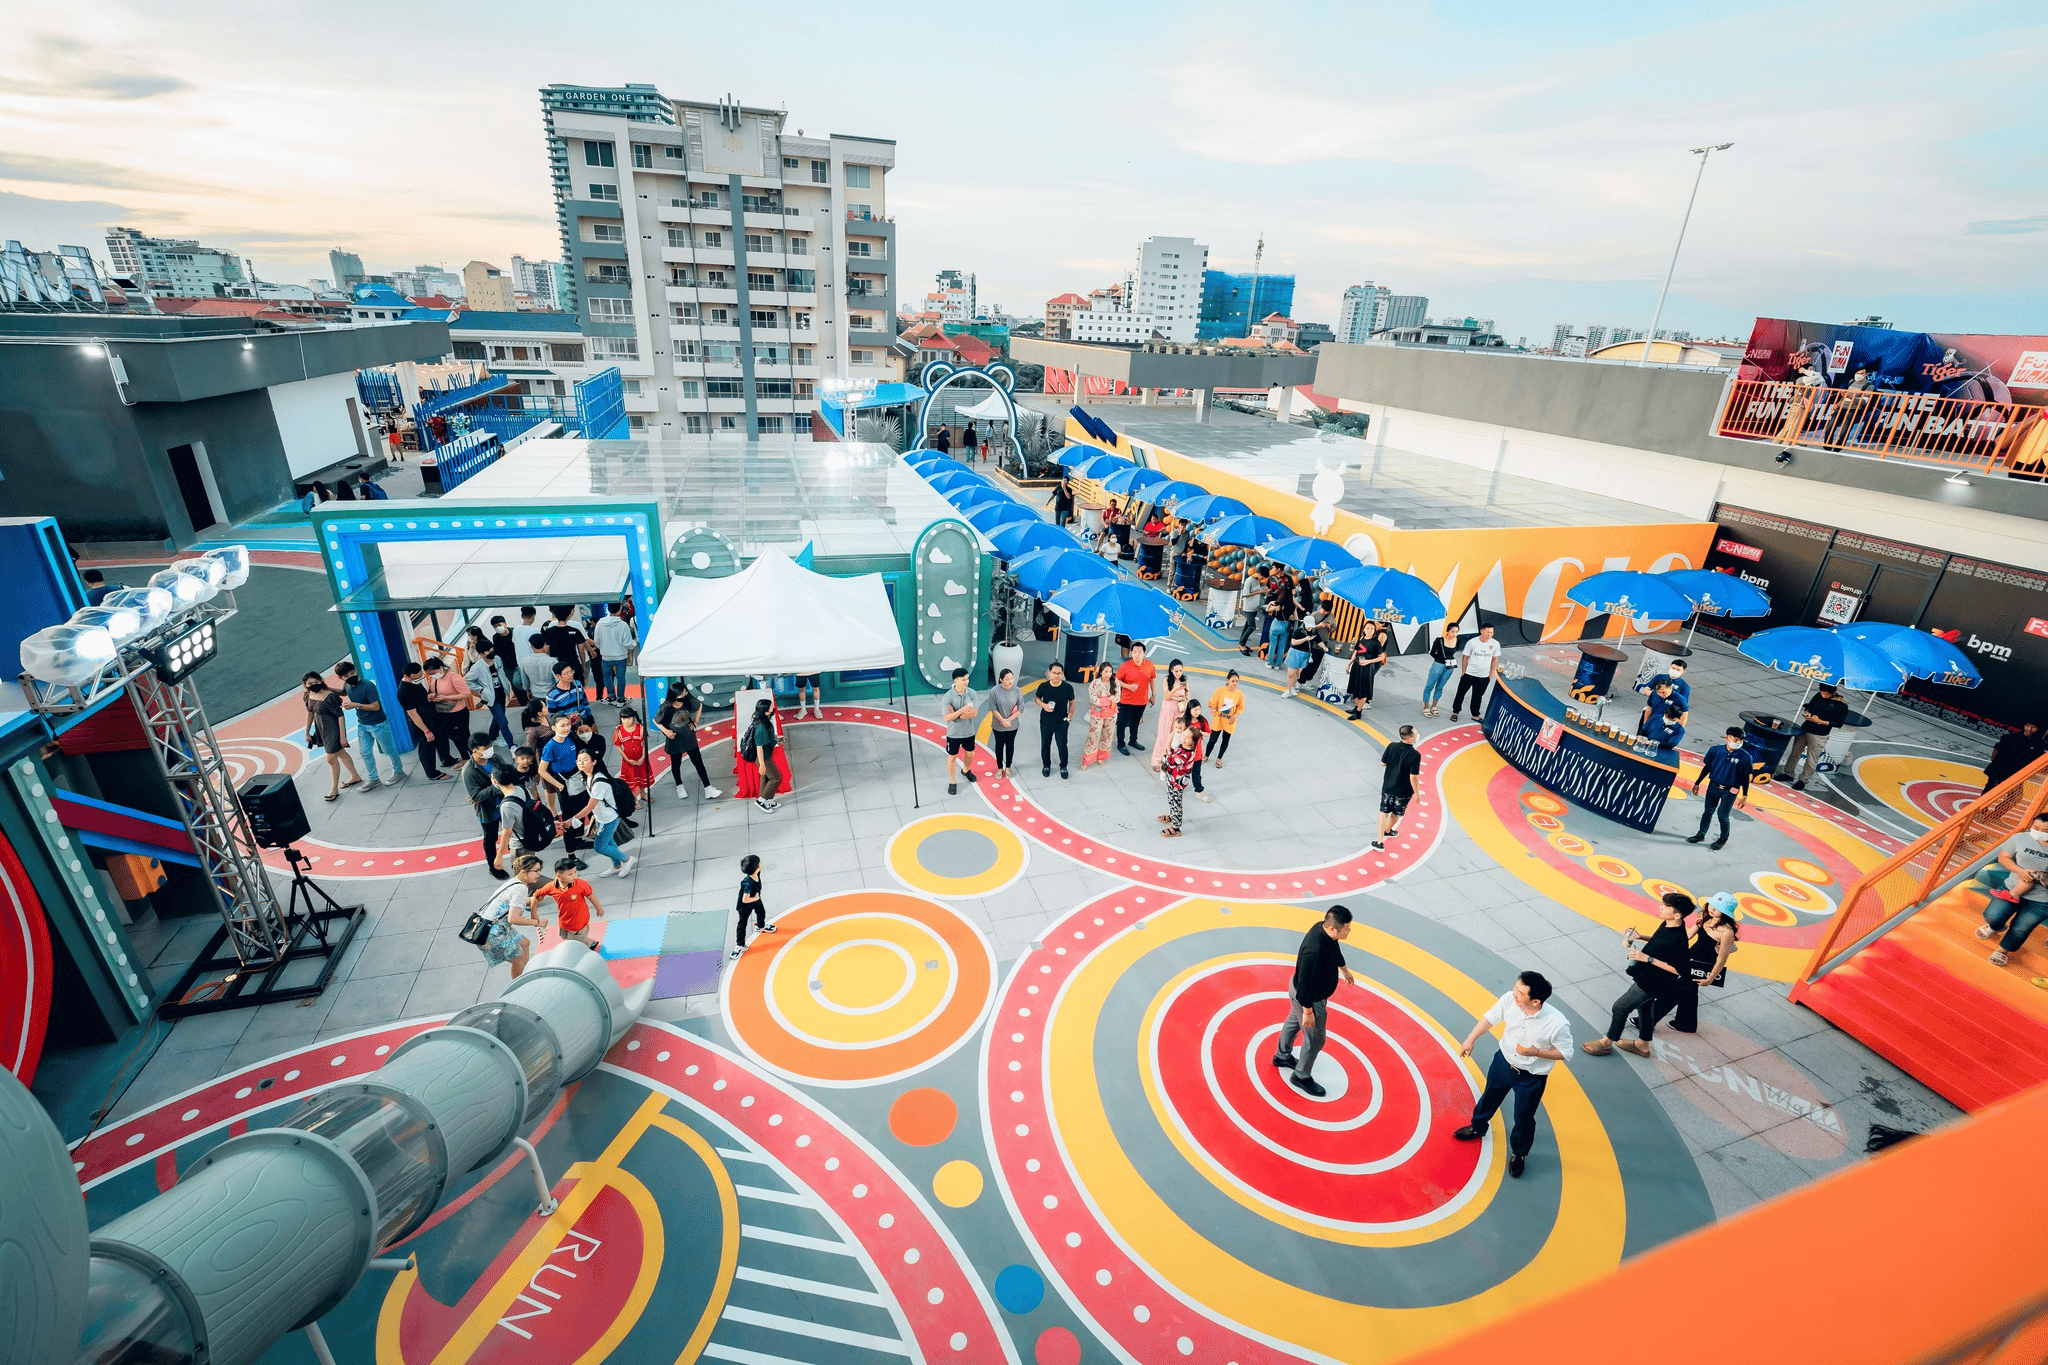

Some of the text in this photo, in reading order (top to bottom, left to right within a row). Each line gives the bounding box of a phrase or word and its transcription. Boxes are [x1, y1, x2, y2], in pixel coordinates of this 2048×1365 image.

[565, 91, 632, 102] GARDEN ONE
[1787, 352, 1812, 370] Tiger
[1921, 362, 1966, 382] Tiger
[1763, 380, 1794, 399] THE
[1746, 401, 1782, 419] FUN
[1875, 411, 1919, 431] FUN
[1372, 608, 1406, 623] Tiger
[1603, 601, 1638, 617] Tiger
[1966, 633, 2012, 659] bpm
[1787, 660, 1833, 682] Tiger
[1941, 670, 1973, 686] Tiger
[496, 1229, 602, 1340] RUN
